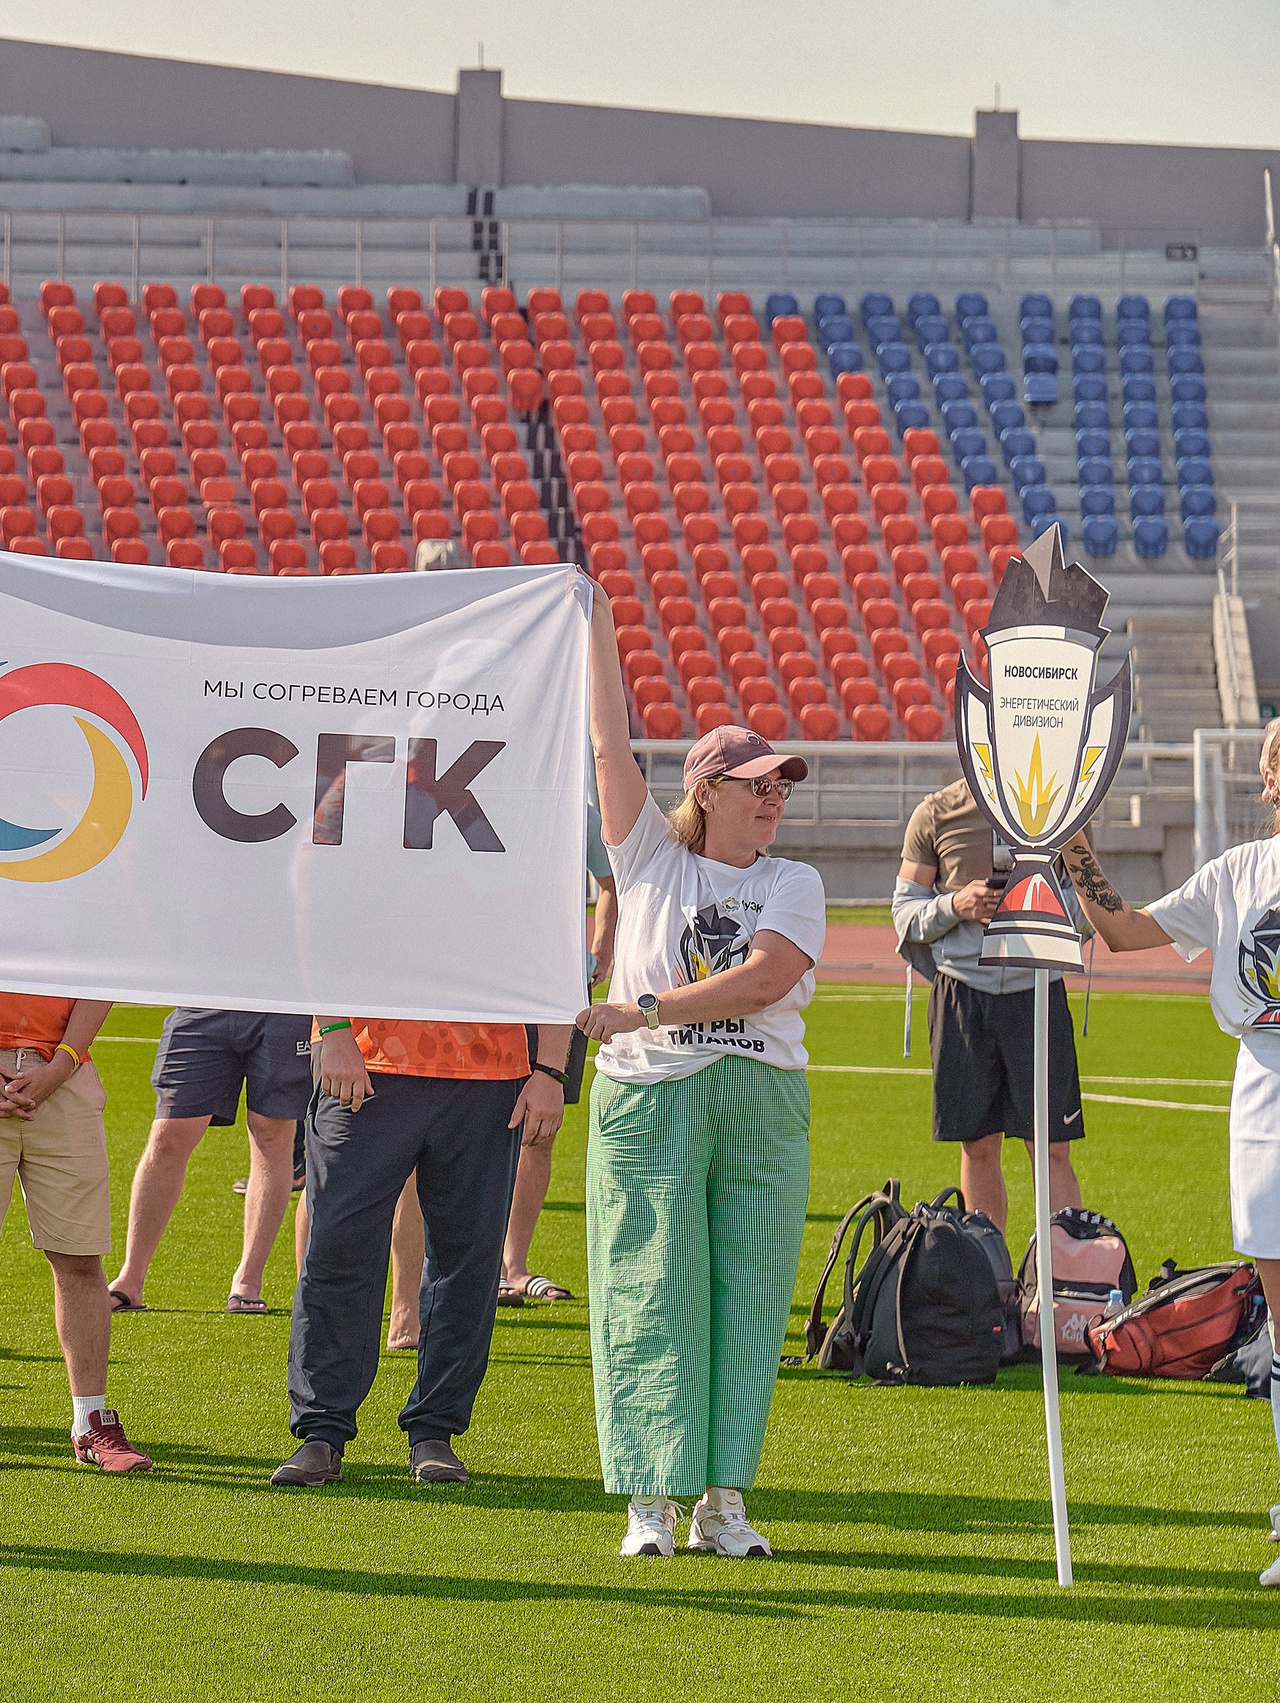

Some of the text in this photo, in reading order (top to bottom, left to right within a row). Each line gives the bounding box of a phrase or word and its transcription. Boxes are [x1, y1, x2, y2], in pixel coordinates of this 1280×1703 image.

[1004, 665, 1079, 680] НОВОСИБИРСК
[203, 680, 505, 716] МЫ СОГРЕВАЕМ ГОРОДА
[999, 696, 1079, 712] ЭНЕРГЕТИЧЕСКИЙ
[1012, 714, 1064, 729] ДИВИЗИОН
[192, 726, 507, 853] СГК
[296, 1040, 311, 1052] EA
